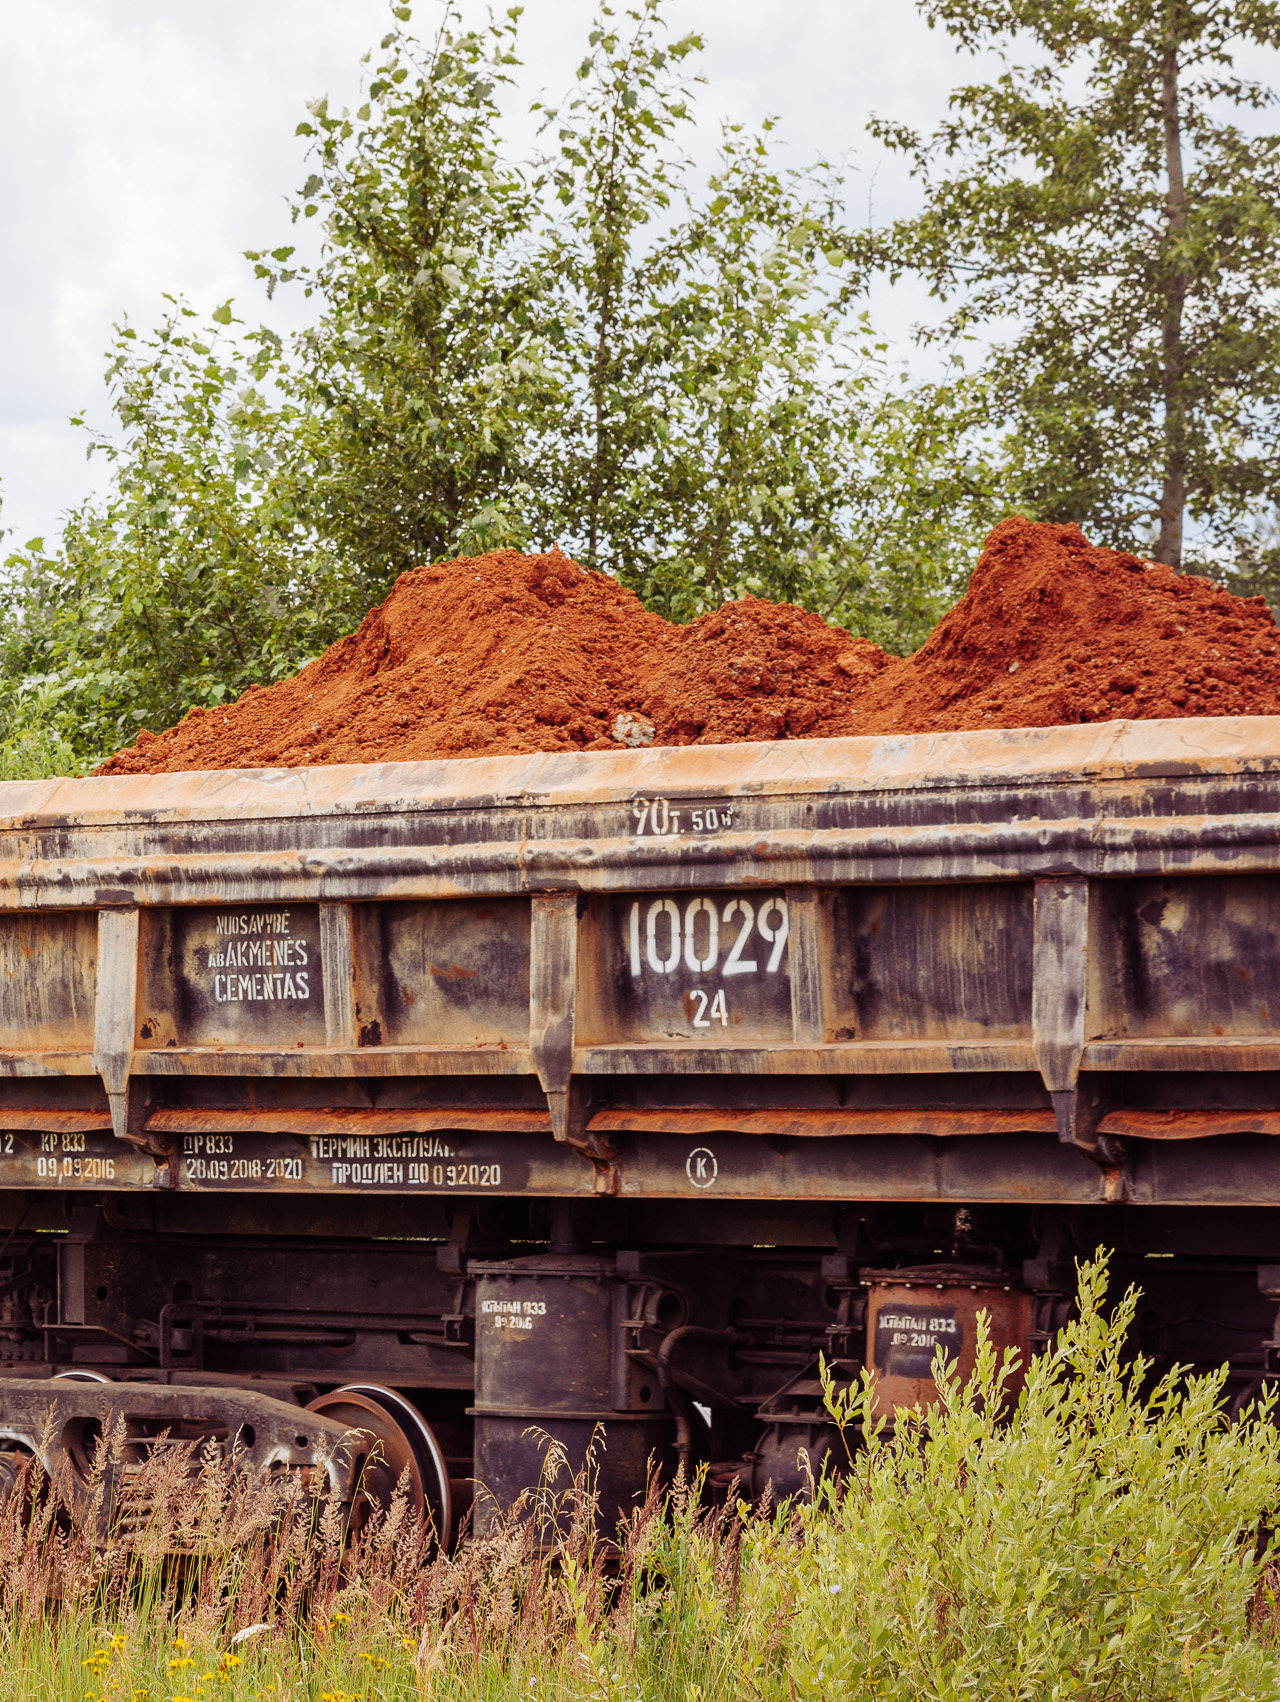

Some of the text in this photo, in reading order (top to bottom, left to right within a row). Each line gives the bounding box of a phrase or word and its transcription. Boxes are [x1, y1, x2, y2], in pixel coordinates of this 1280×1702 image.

[216, 909, 291, 935] NUOSAVYBĖ
[630, 897, 789, 977] 10029
[225, 936, 308, 967] AKMENĖS
[214, 971, 310, 1002] CEMENTAS
[689, 989, 728, 1027] 24
[41, 1133, 86, 1152] КР 833
[206, 1134, 234, 1154] 833
[310, 1135, 370, 1158] ТЕРМИН
[332, 1162, 404, 1184] ПРОДЛЕН
[407, 1162, 429, 1184] ДО
[523, 1301, 547, 1315] 833
[929, 1317, 956, 1333] 833
